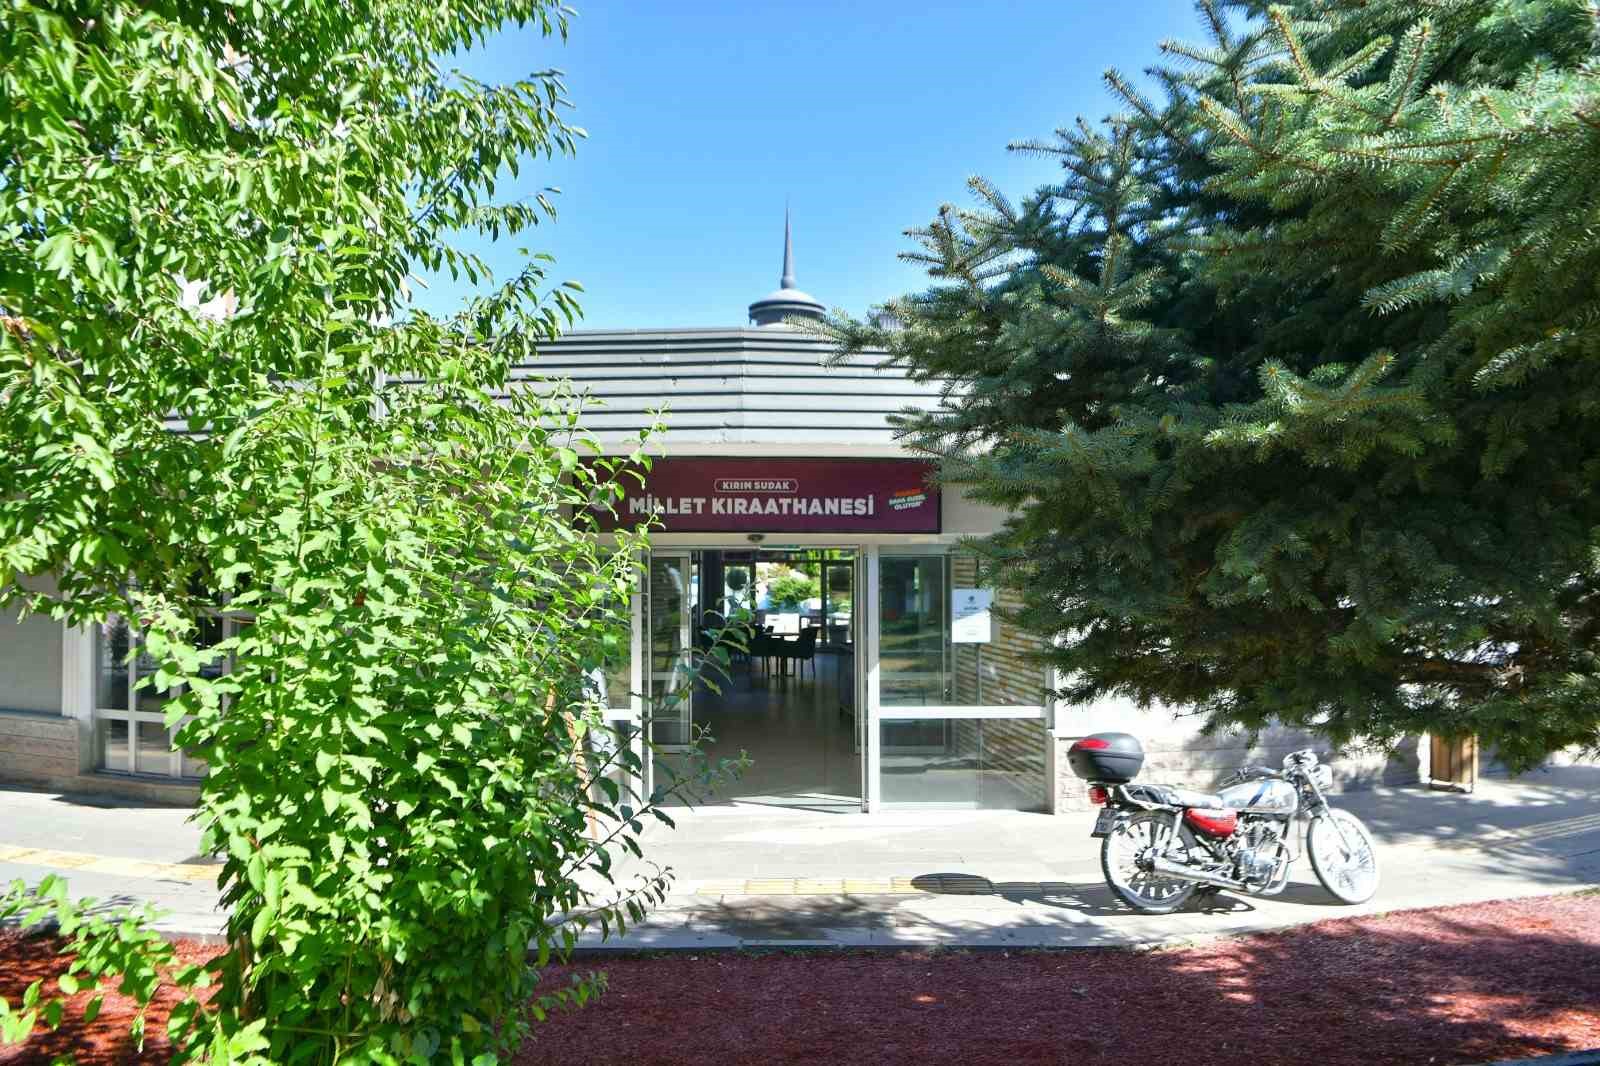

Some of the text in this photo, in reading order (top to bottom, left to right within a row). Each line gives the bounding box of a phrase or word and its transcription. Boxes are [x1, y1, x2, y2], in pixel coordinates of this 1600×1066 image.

[722, 481, 790, 490] KIRIM SUDAK
[629, 493, 706, 514] MİLLET
[711, 494, 874, 515] KIRAATHANESİ
